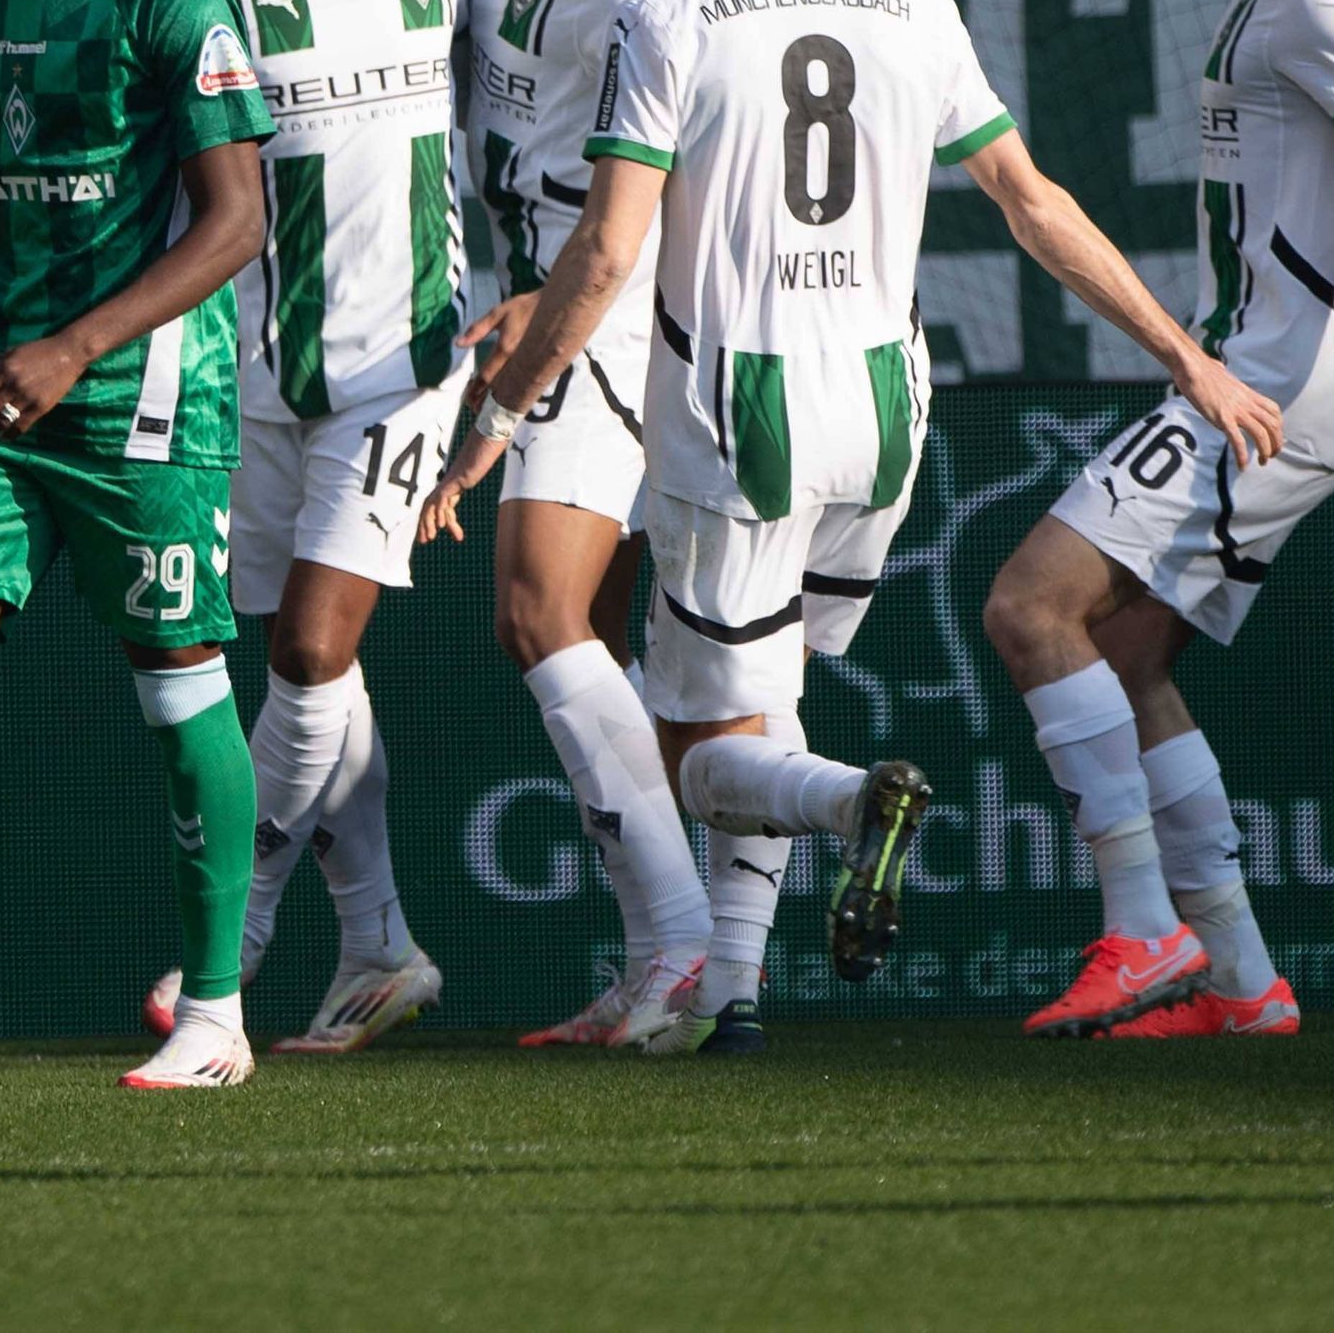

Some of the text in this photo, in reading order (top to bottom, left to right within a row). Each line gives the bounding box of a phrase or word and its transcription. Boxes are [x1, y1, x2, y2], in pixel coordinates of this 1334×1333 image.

[261, 57, 449, 109] REUTER
[596, 68, 618, 130] sonepar
[781, 33, 857, 226] 8
[777, 249, 862, 291] WEIGL
[362, 423, 425, 507] 14
[1109, 413, 1198, 490] 16
[125, 543, 196, 621] 29
